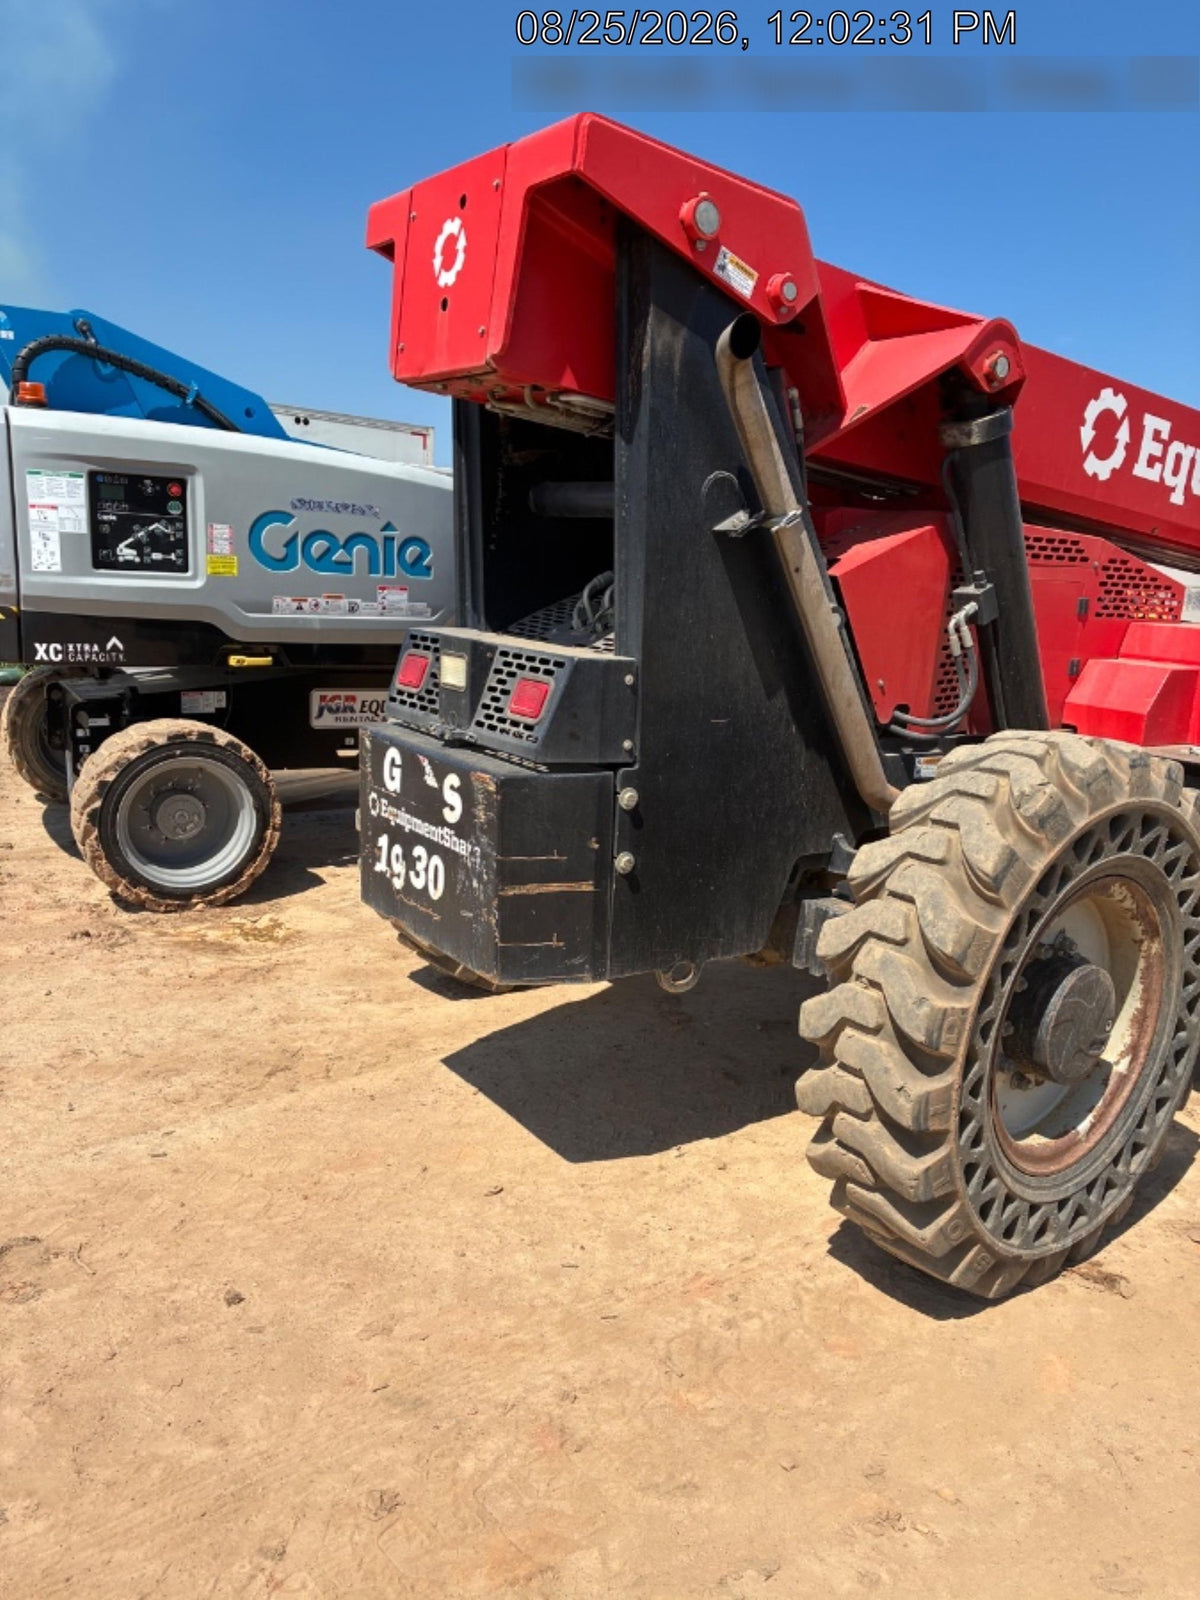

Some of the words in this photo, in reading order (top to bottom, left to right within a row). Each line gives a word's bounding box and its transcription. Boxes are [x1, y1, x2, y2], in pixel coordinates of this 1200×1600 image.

[248, 510, 433, 580] Genie
[34, 642, 63, 662] XC
[374, 833, 445, 901] 1930
